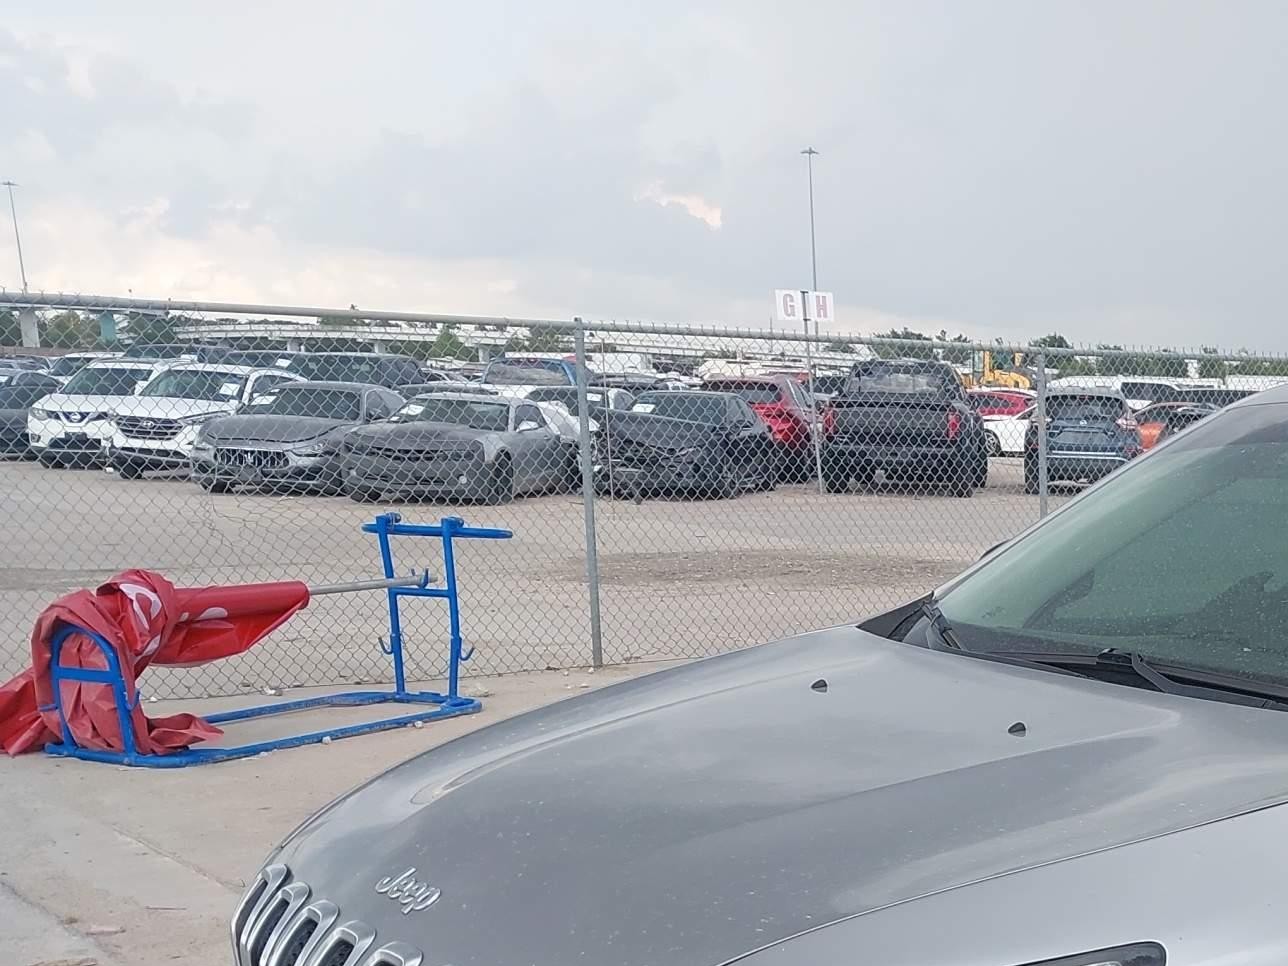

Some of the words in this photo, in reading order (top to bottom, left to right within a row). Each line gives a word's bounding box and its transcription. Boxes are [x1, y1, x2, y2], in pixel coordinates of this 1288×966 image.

[783, 293, 796, 317] G
[816, 295, 828, 318] H
[375, 866, 441, 915] Jeep
